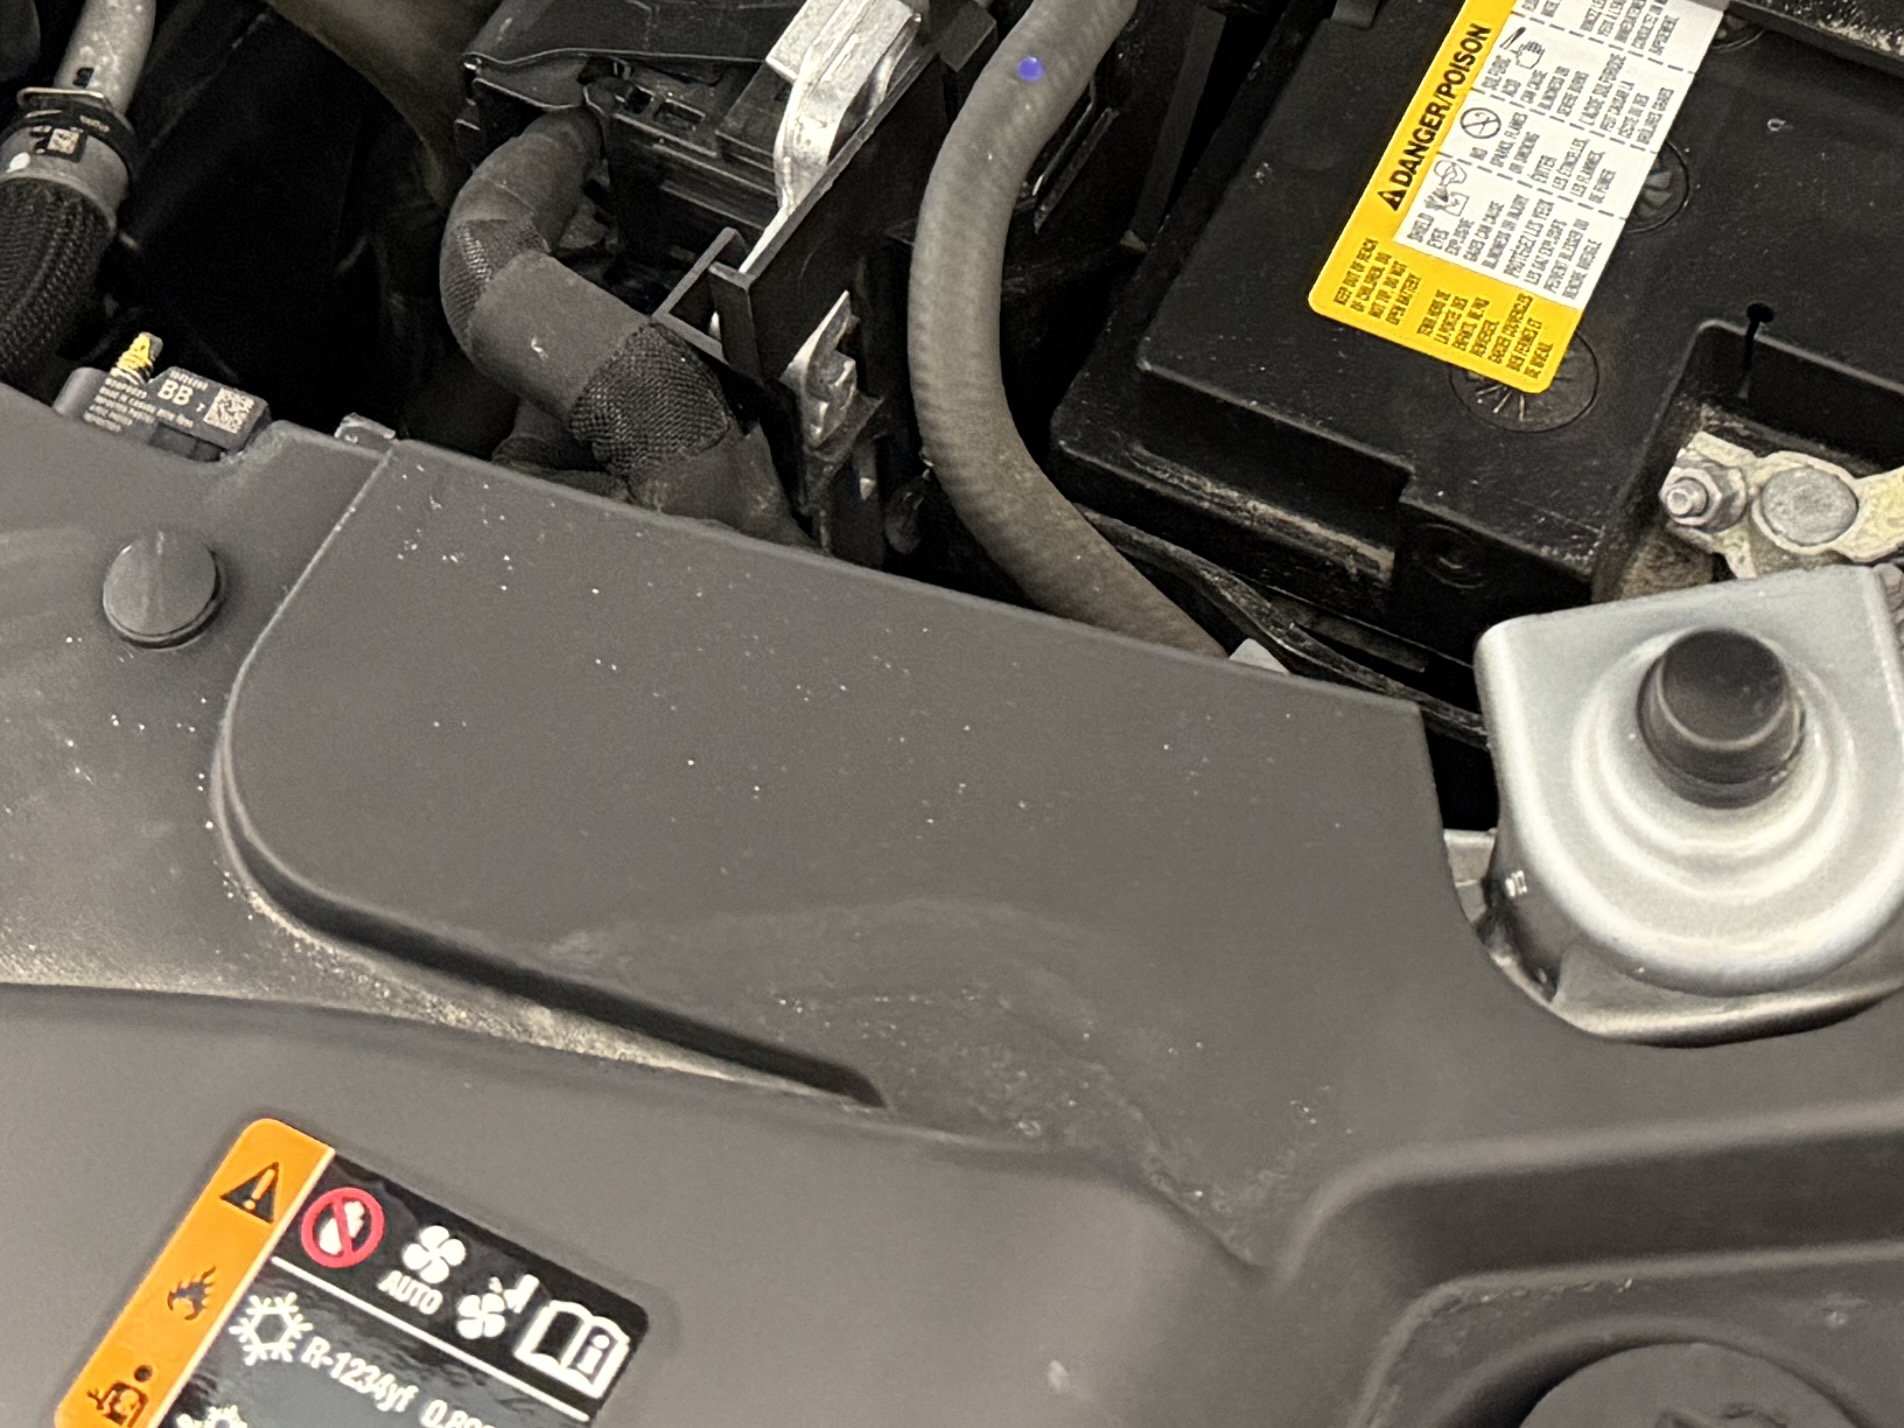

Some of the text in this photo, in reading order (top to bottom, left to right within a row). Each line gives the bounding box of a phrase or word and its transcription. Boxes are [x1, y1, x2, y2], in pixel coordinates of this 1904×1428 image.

[1389, 24, 1488, 184] DANGER/POISON
[157, 379, 194, 407] BB
[377, 1269, 445, 1316] AUTO
[300, 1335, 421, 1413] R-1234yf
